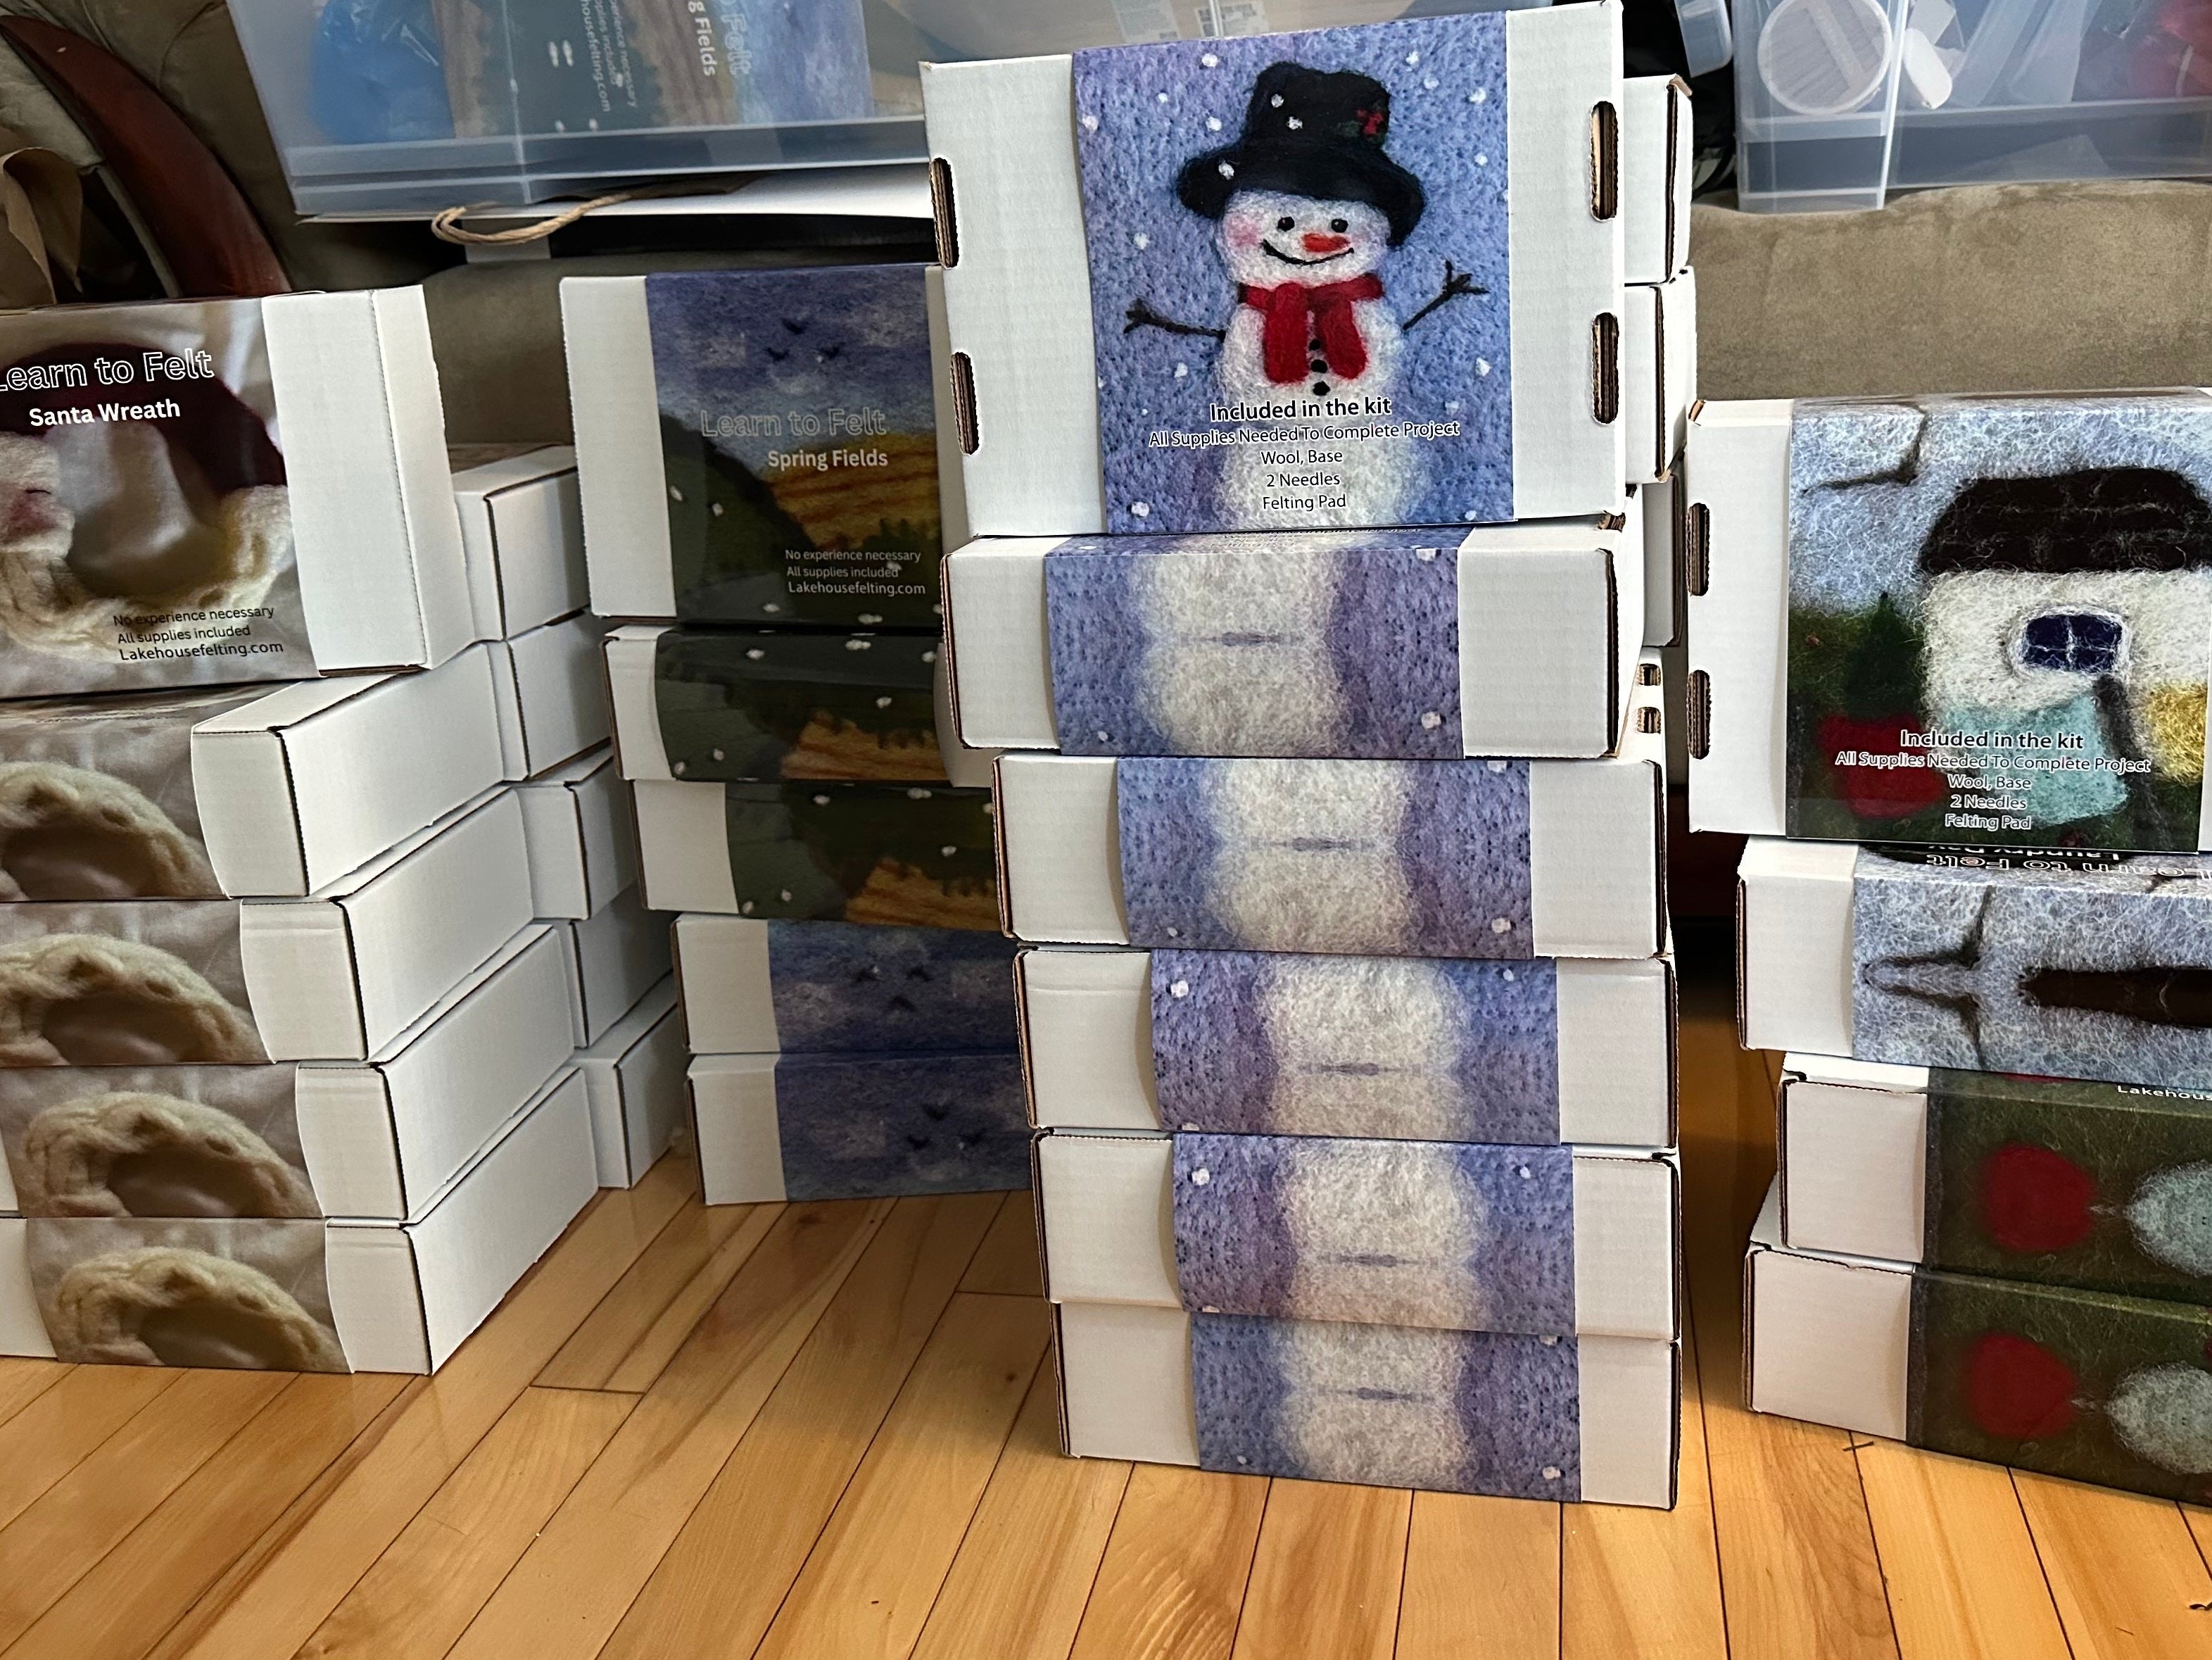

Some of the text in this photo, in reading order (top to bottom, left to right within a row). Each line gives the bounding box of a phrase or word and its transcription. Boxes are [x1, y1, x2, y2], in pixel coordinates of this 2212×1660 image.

[694, 18, 718, 76] Fields
[94, 358, 134, 384] to
[143, 348, 215, 382] Felt
[29, 398, 181, 427] Santa Wreath
[1209, 396, 1391, 422] Included in the kit
[700, 407, 887, 437] Learn to Felt
[1149, 420, 1460, 448] All Supplies Needed To Complete Project
[768, 448, 889, 472] Spring Fields
[1260, 450, 1344, 465] Wool, Base
[1266, 473, 1341, 488] 2 Needles
[1262, 494, 1346, 511] Felting Pad
[785, 550, 921, 563] No experience necessary
[787, 567, 899, 579] All supplies included
[788, 581, 925, 597] Lakehousefelting.com
[113, 606, 274, 627] No experience necessary
[118, 624, 251, 644] All supplies included
[119, 641, 284, 661] Lakehousefelting.com
[1900, 729, 2085, 750] Included in the kit
[1835, 751, 2151, 776] All Supplies Needed To Complete Project
[1947, 776, 2032, 791] Wool, Base
[1950, 796, 2027, 810] 2 Needles
[1945, 814, 2032, 830] Felting Pad
[1926, 854, 2009, 871] Felt
[2023, 860, 2071, 872] to
